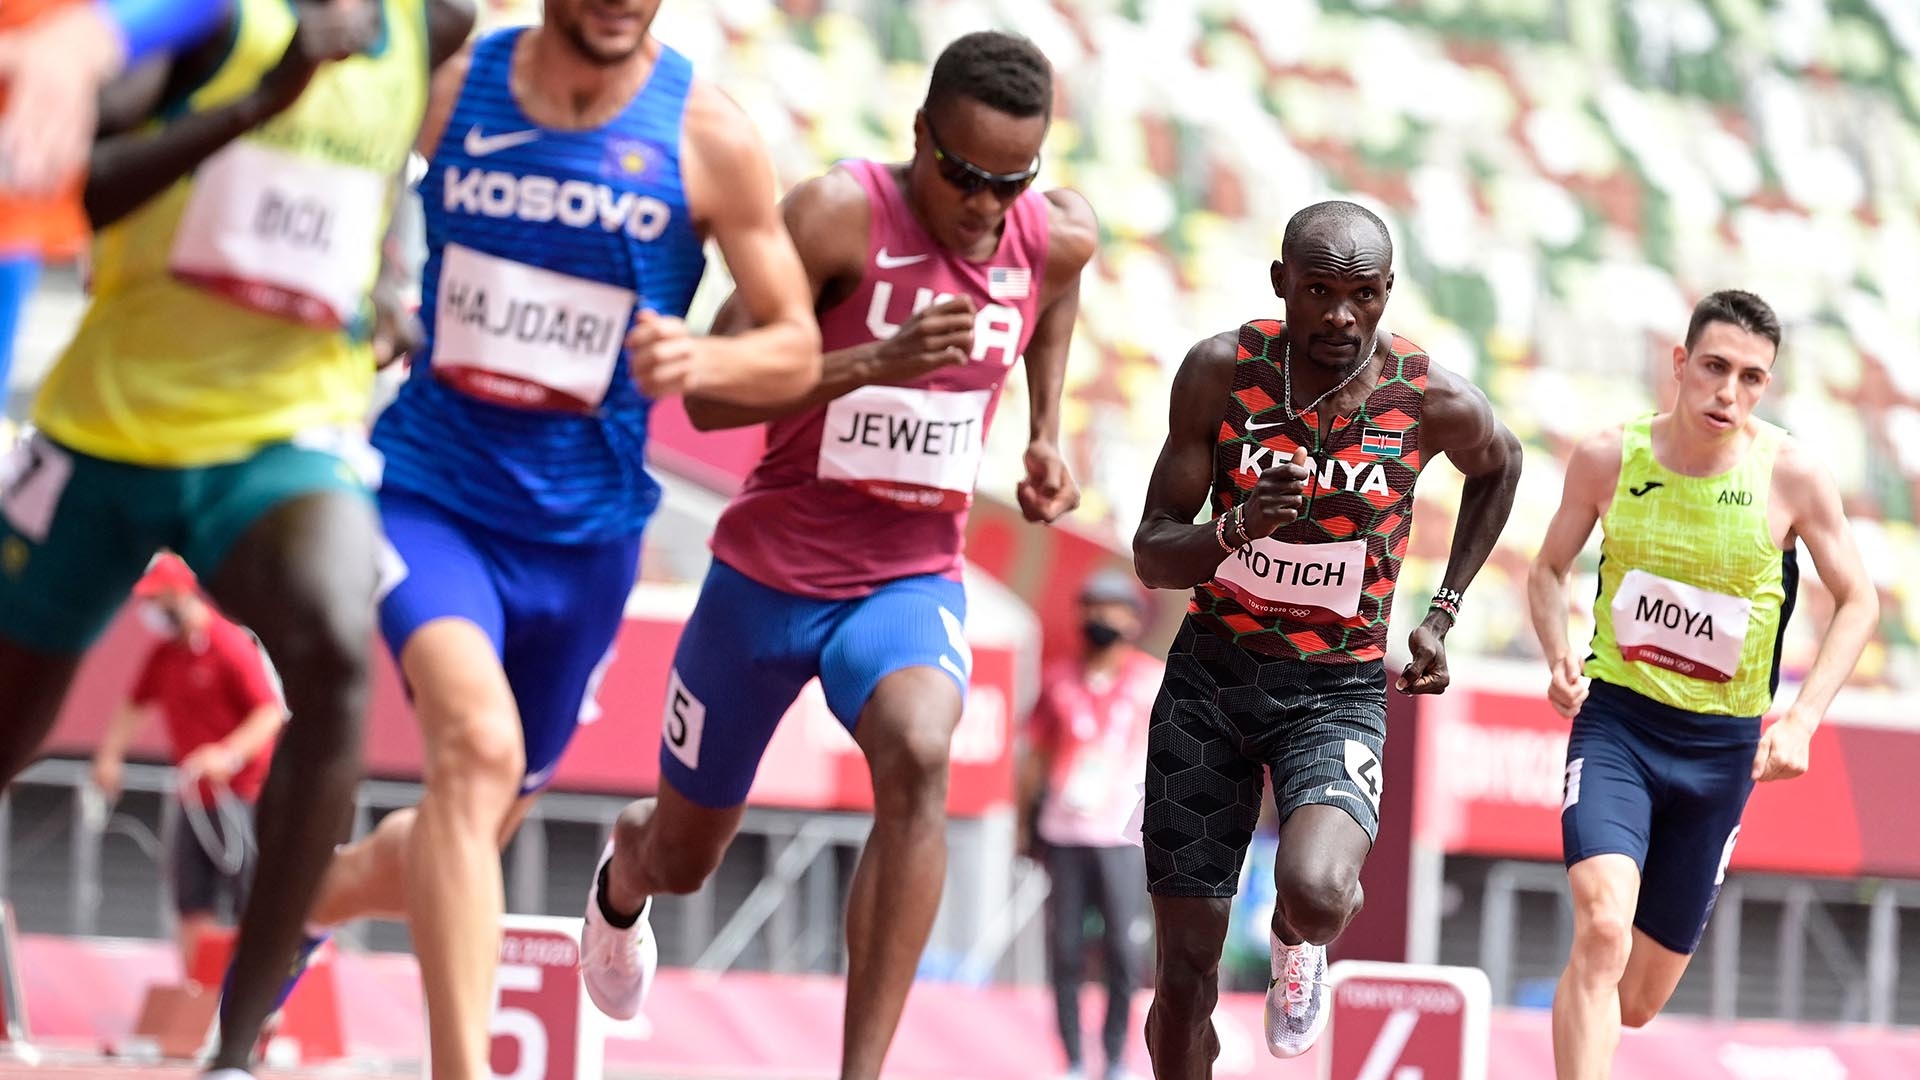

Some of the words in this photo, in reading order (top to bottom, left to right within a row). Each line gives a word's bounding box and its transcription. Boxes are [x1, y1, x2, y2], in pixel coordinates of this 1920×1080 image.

[443, 165, 671, 242] KOSOVO
[446, 279, 616, 356] HAJDARI
[865, 279, 1023, 366] UA
[838, 411, 975, 456] JEWETT
[1717, 489, 1753, 506] AND
[1237, 540, 1346, 586] ROTICH
[1247, 598, 1269, 612] TOKYO
[1635, 595, 1714, 641] MOYA
[667, 689, 689, 748] 5
[1357, 757, 1378, 797] 4
[487, 965, 548, 1080] 5
